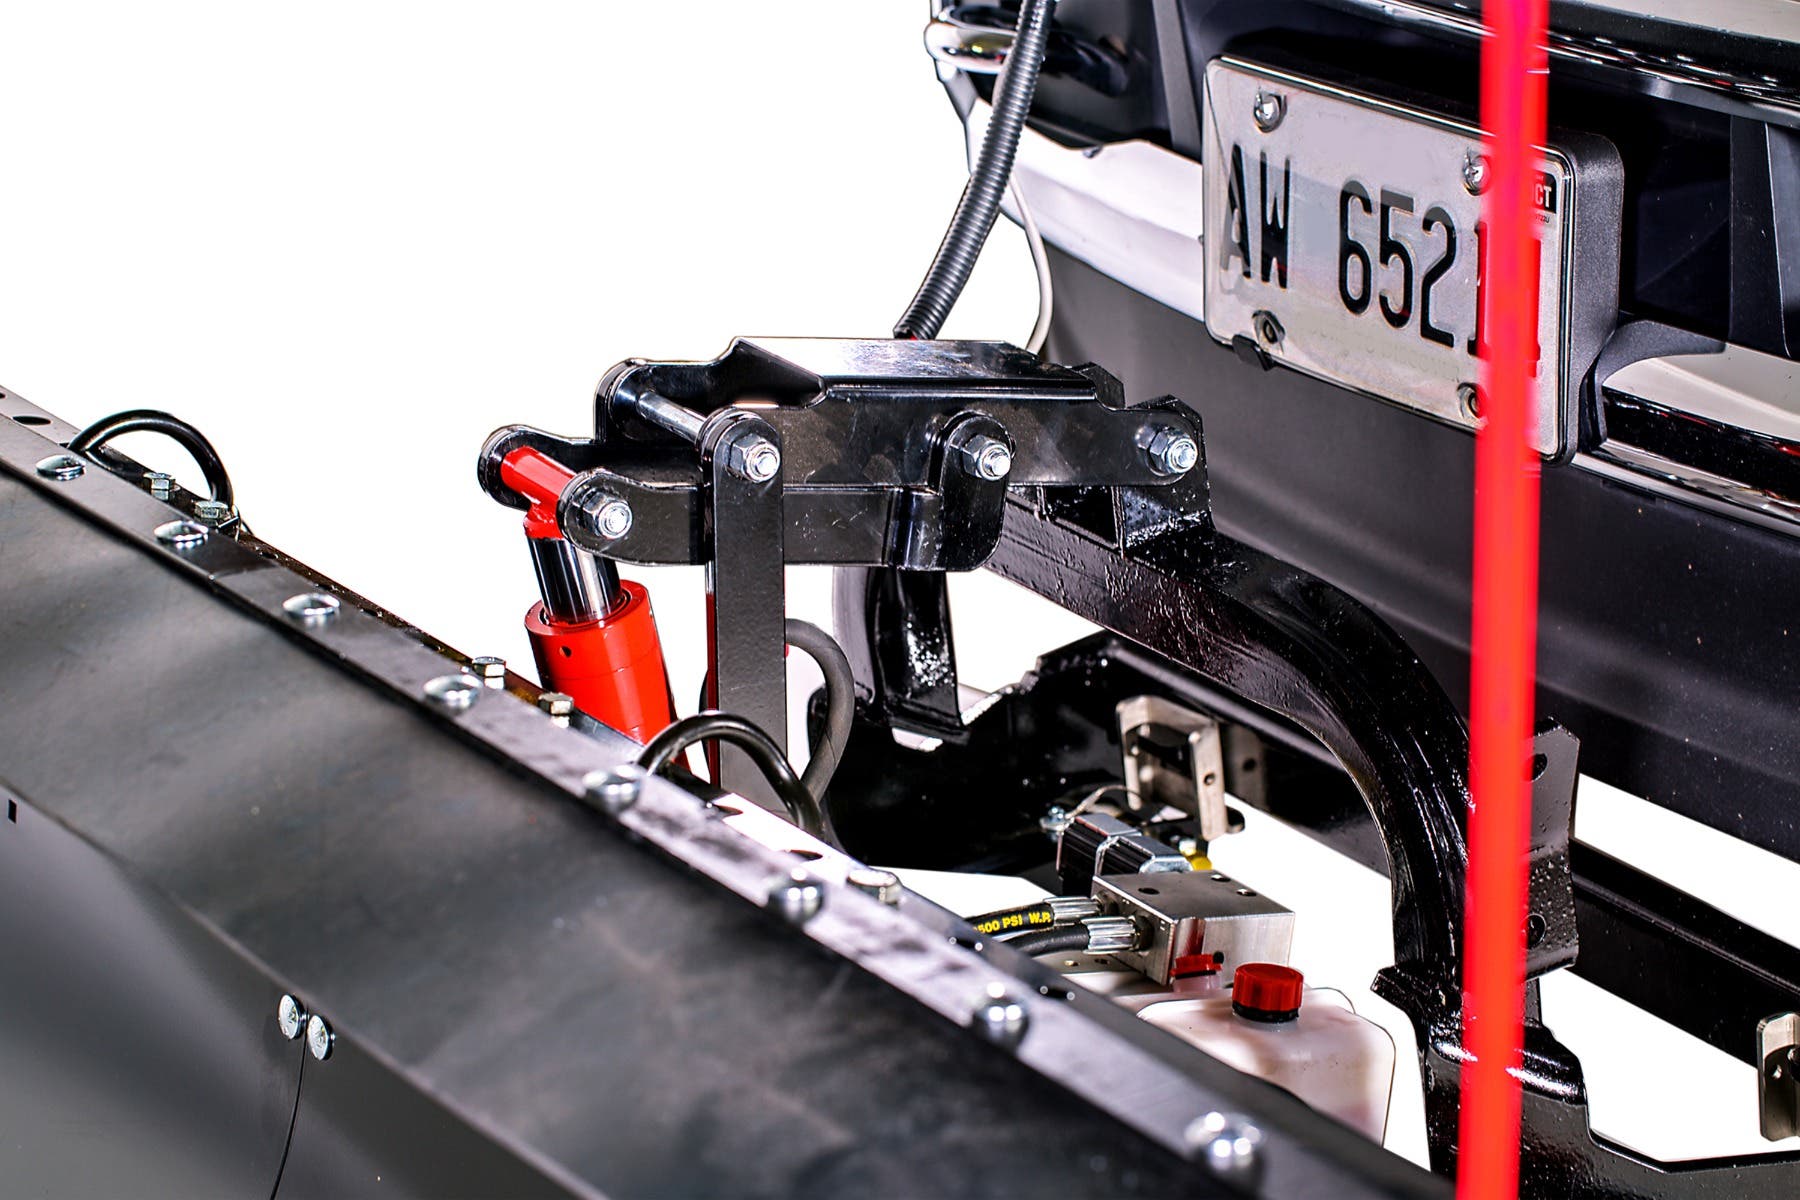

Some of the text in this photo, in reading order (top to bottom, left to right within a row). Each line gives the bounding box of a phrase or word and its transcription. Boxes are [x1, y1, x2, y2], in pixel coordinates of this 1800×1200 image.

[1222, 143, 1290, 289] AW
[973, 920, 1000, 934] 500
[1002, 915, 1022, 928] PSI
